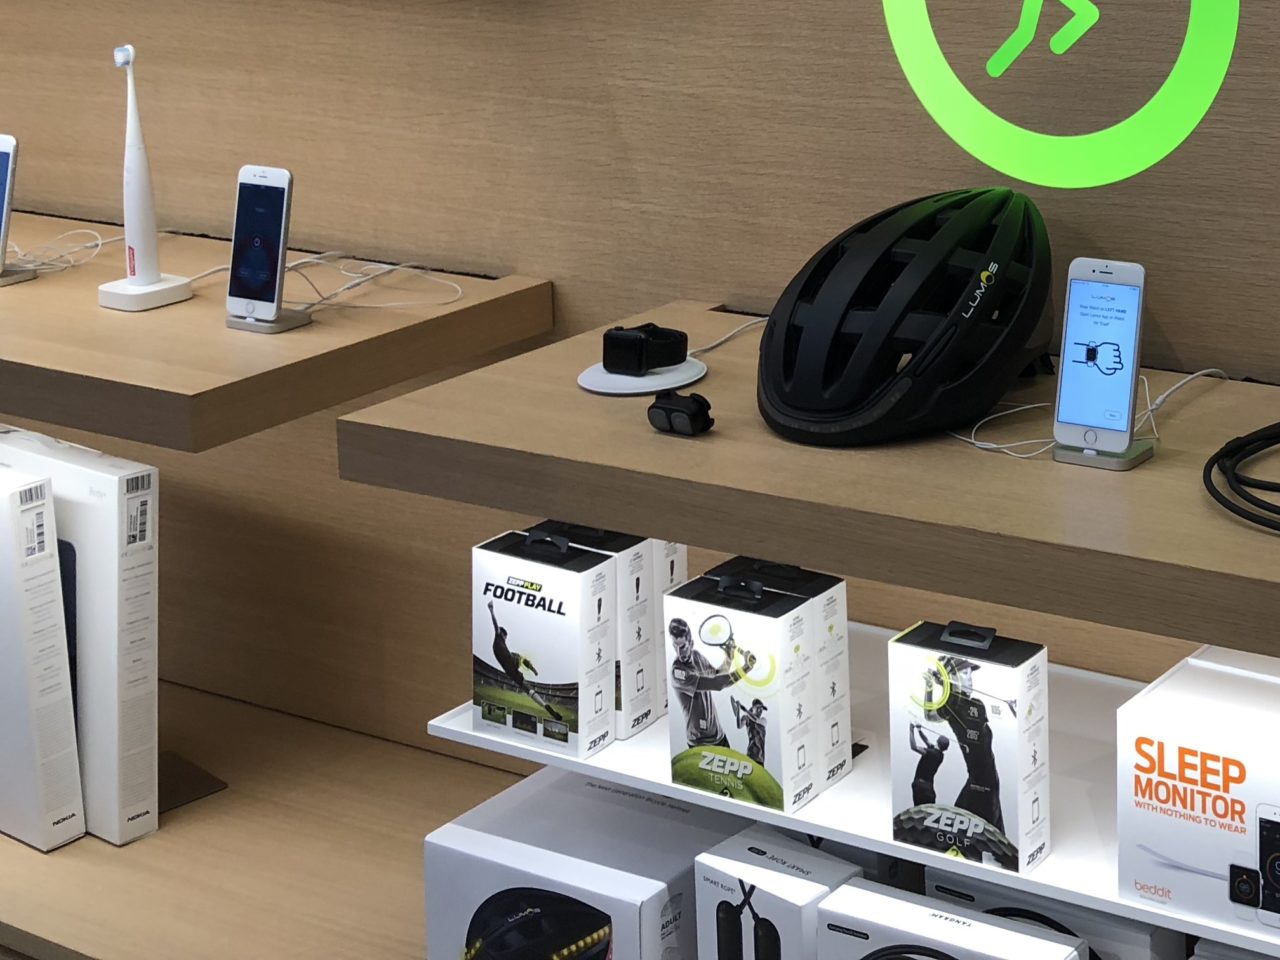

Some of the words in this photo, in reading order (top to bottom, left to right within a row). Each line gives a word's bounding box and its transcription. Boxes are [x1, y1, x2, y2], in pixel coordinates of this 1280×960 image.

[962, 262, 998, 318] LUMOS
[483, 582, 566, 616] FOOTBALL
[631, 708, 652, 728] ZEPP
[587, 730, 608, 751] ZEPP
[698, 751, 753, 779] ZEPP
[827, 760, 846, 780] ZEPP
[1134, 736, 1246, 794] SLEEP
[708, 772, 744, 790] TENNIS
[792, 783, 812, 805] ZEPP
[1134, 774, 1246, 824] MONITOR
[52, 813, 76, 826] NOKIA
[126, 810, 150, 823] NOKIA
[924, 809, 985, 837] ZEPP
[1134, 800, 1158, 812] WITH
[1160, 806, 1202, 824] NOTHING
[1203, 817, 1217, 828] TO
[1218, 821, 1247, 835] WEAR
[936, 832, 970, 848] GOLF
[1026, 842, 1046, 866] ZEPP
[1134, 879, 1172, 900] beddit
[660, 911, 682, 931] ADULT
[931, 913, 972, 928] TANGRAM
